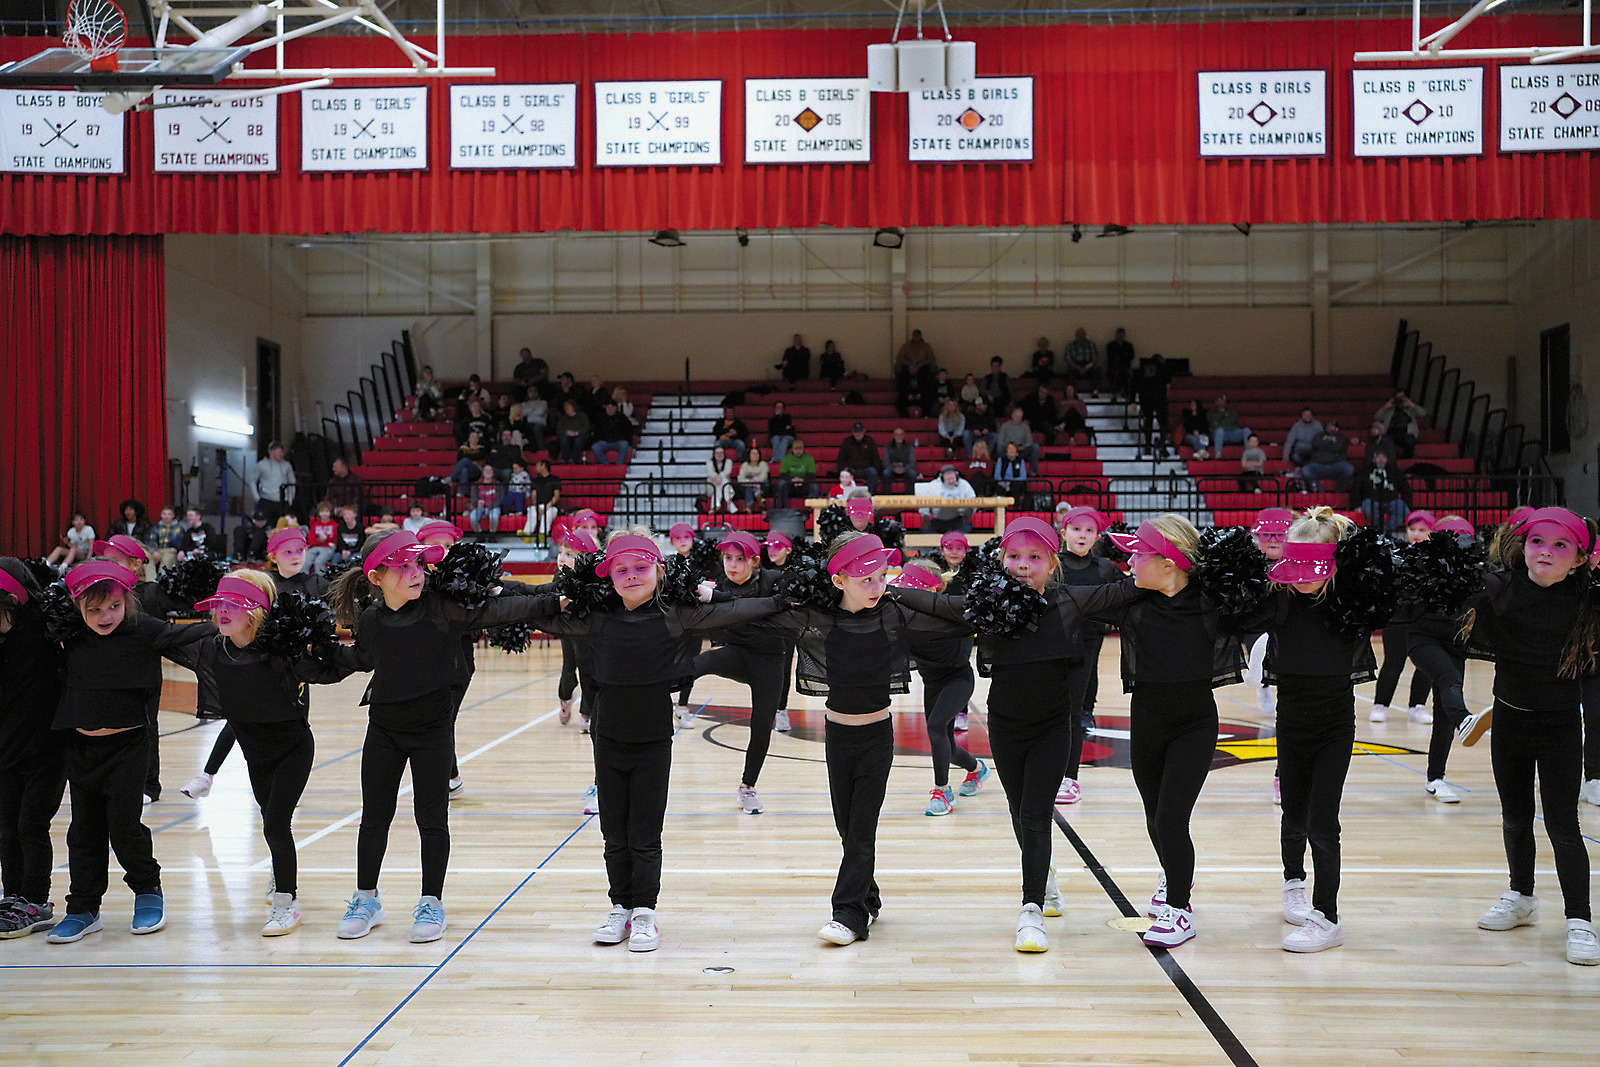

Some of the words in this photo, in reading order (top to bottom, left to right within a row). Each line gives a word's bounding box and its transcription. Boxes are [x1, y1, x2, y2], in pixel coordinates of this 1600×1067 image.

[1212, 82, 1252, 94] CLASS
[1260, 82, 1267, 94] B
[1274, 82, 1311, 94] GIRLS
[1363, 81, 1401, 94] CLASS
[1408, 80, 1415, 93] B
[1511, 75, 1549, 89] CLASS
[1556, 75, 1564, 87] B
[606, 92, 641, 104] CLASS
[650, 92, 657, 103] B
[756, 90, 792, 102] CLASS
[799, 89, 806, 101] B
[922, 88, 961, 100] CLASS
[968, 89, 975, 100] B
[982, 88, 1018, 100] GIRLS
[16, 95, 52, 107] CLASS
[58, 96, 66, 107] B
[312, 99, 347, 111] CLASS
[354, 98, 361, 110] B
[460, 95, 496, 107] CLASS
[503, 95, 510, 107] B
[1530, 101, 1546, 113] 20
[1585, 100, 1600, 112] 08
[1228, 107, 1244, 119] 20
[1281, 107, 1296, 119] 19
[1383, 107, 1398, 119] 20
[1438, 105, 1453, 117] 10
[482, 120, 495, 132] 19
[530, 120, 544, 132] 92
[628, 117, 641, 129] 19
[675, 116, 689, 128] 99
[775, 114, 790, 126] 20
[826, 113, 841, 125] 05
[937, 114, 952, 126] 20
[989, 114, 1003, 126] 20
[22, 124, 33, 135] 19
[86, 124, 100, 136] 87
[168, 123, 180, 136] 19
[247, 124, 263, 136] 88
[334, 123, 347, 135] 19
[381, 122, 394, 135] 91
[1508, 127, 1544, 140] STATE
[912, 138, 952, 150] STATE
[958, 138, 1030, 150] CHAMPIONS
[1203, 133, 1243, 144] STATE
[1249, 132, 1322, 144] CHAMPIONS
[1362, 132, 1397, 145] STATE
[1406, 131, 1475, 144] CHAMPIONS
[460, 145, 495, 157] STATE
[502, 144, 566, 156] CHAMPIONS
[606, 142, 641, 154] STATE
[648, 141, 710, 154] CHAMPIONS
[754, 140, 787, 152] STATE
[797, 139, 862, 151] CHAMPIONS
[161, 153, 197, 165] STATE
[204, 153, 269, 165] CHAMPIONS
[311, 148, 346, 160] STATE
[353, 147, 417, 159] CHAMPIONS
[13, 156, 45, 168] STATE
[54, 156, 112, 169] CHAMPIONS
